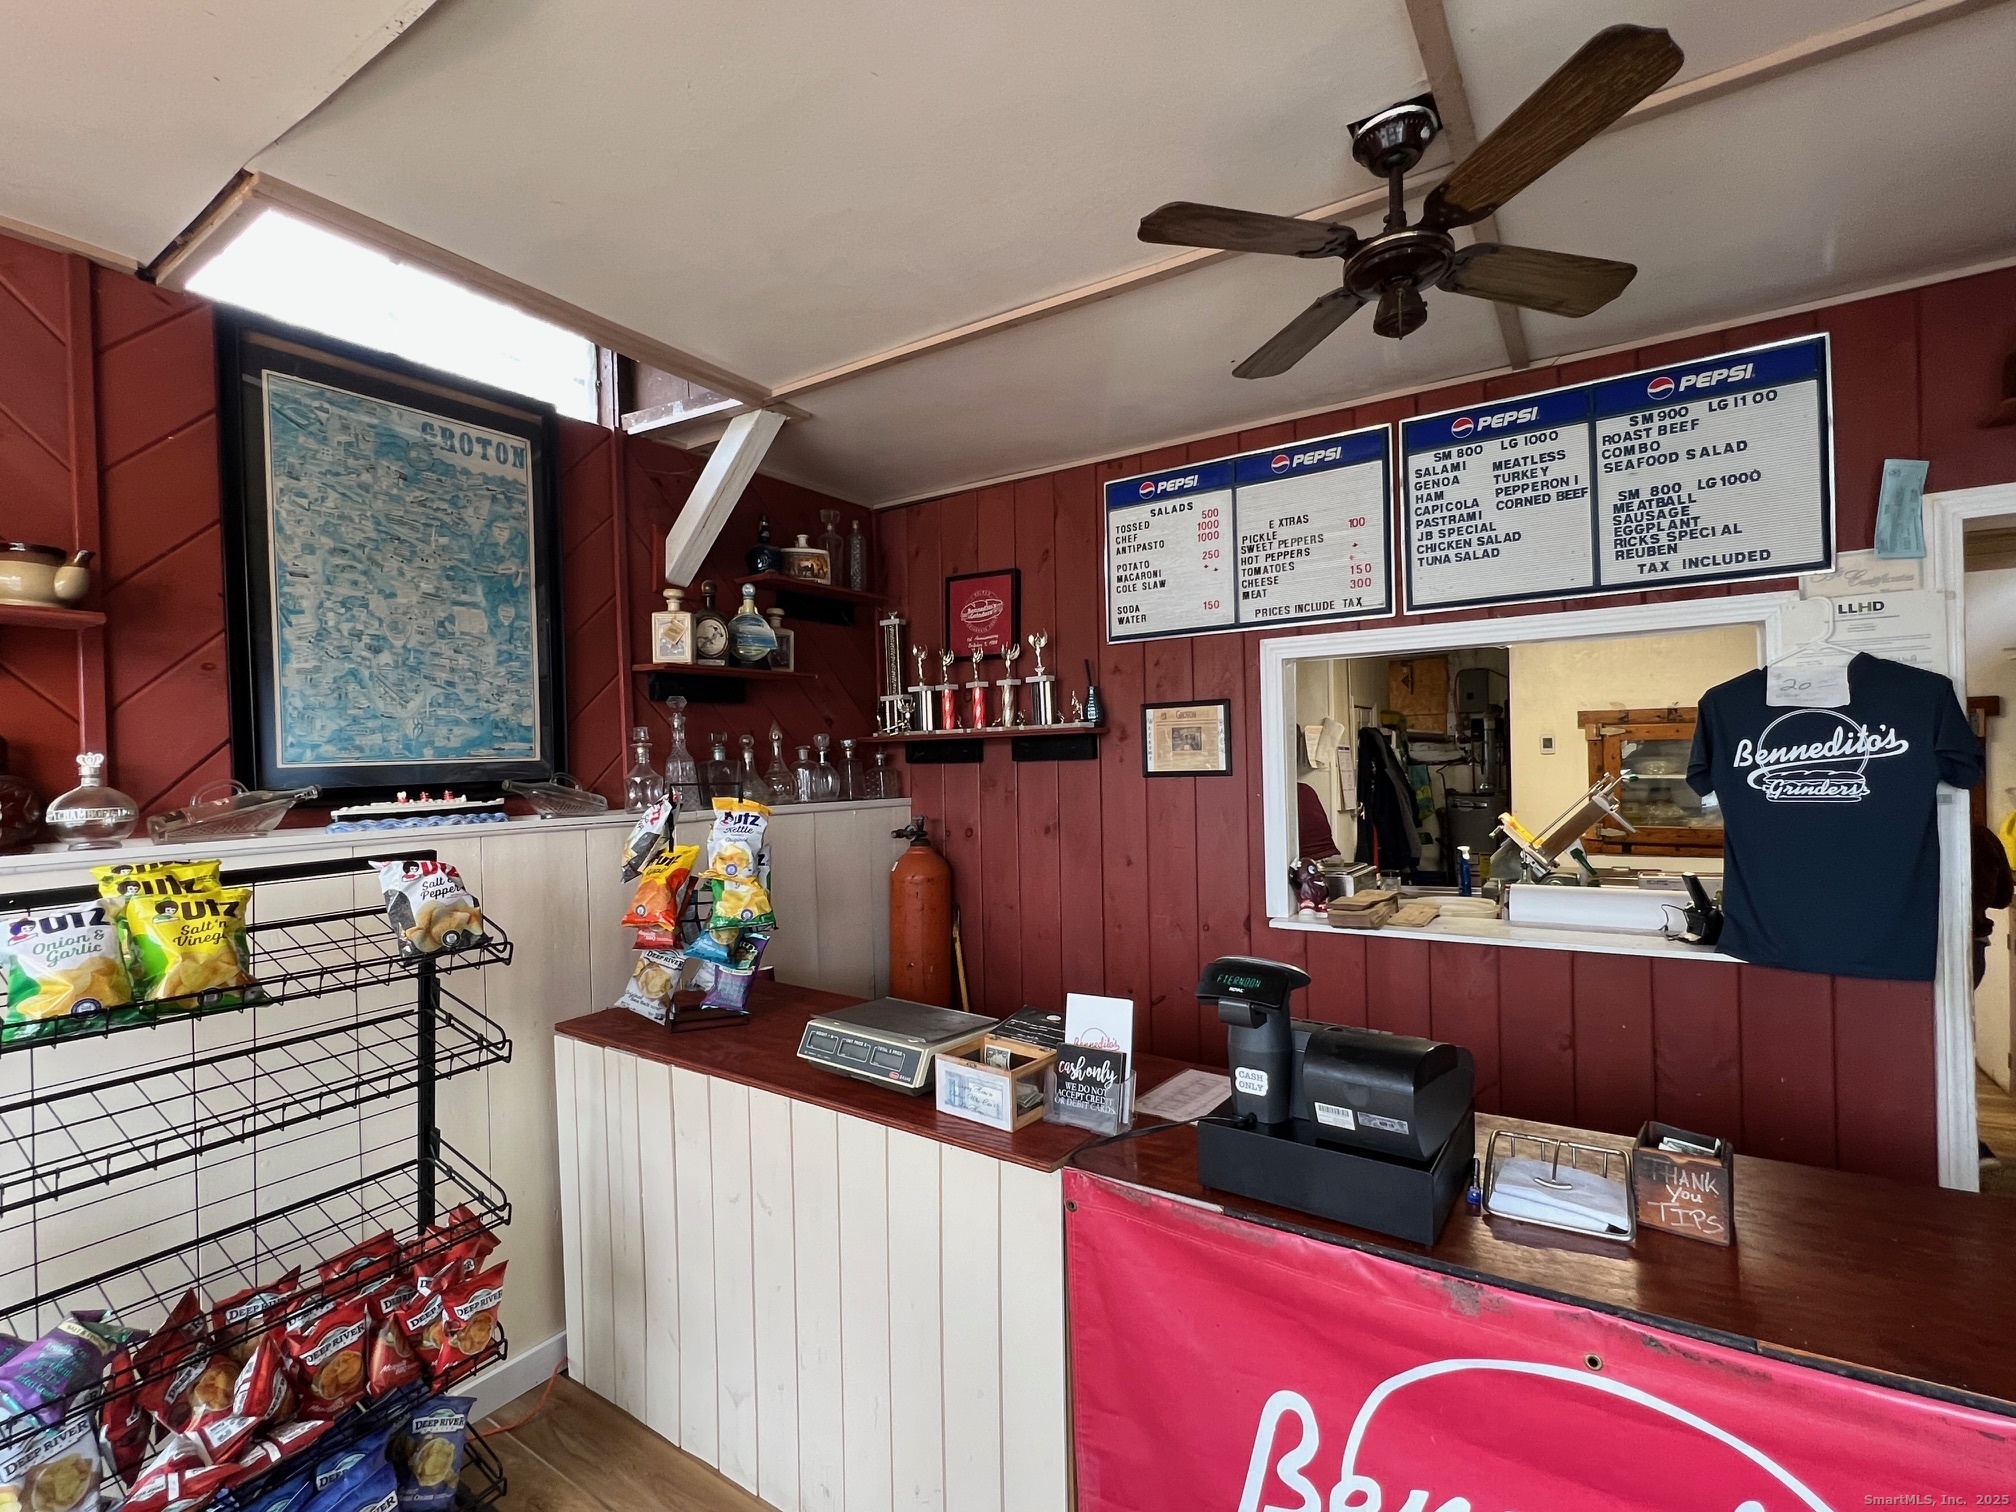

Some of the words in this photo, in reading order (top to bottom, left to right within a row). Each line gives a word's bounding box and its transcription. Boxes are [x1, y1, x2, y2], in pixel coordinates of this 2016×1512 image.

[1678, 363, 1754, 392] PEPSI
[1477, 406, 1539, 431] PEPSI
[1629, 413, 1654, 427] SM
[1657, 406, 1689, 422] 900
[1708, 399, 1729, 413] LG
[1602, 427, 1652, 447] ROAST
[1657, 418, 1700, 437] BEEF
[1292, 446, 1342, 467] PEPSI
[1434, 450, 1451, 462] SM
[1457, 445, 1483, 458] 800
[1501, 438, 1518, 450] LG
[1524, 430, 1559, 446] 1000
[1602, 440, 1661, 460] COMBO
[1604, 451, 1679, 473] SEAFOOD
[1686, 440, 1748, 460] SALAD
[1415, 461, 1467, 478] SALAMI
[1492, 450, 1566, 472] MEATLESS
[1157, 475, 1198, 494] PEPSI
[1414, 475, 1460, 491] GENOA
[1493, 466, 1549, 485] TURKEY
[1618, 489, 1640, 502] SM
[1650, 482, 1682, 497] 800
[1698, 477, 1717, 491] LG
[1720, 470, 1762, 487] 1000
[1414, 498, 1479, 516] CAPICOLA
[1416, 491, 1444, 504] HAM
[1496, 493, 1551, 511] CORNED
[1556, 486, 1589, 501] BEEF
[1613, 493, 1697, 515] MEATBALL
[1150, 502, 1194, 517] SALADS
[1416, 511, 1482, 529] PASTRAMI
[1612, 505, 1691, 526] SAUSAGE
[1116, 521, 1150, 534] TOSSED
[1202, 508, 1219, 519] 500
[1242, 531, 1277, 545] PICKLE
[1349, 517, 1365, 528] 100
[1614, 516, 1701, 538] EGGPLANT
[1116, 534, 1138, 545] CHEF
[1197, 520, 1219, 531] 1000
[1417, 530, 1433, 542] JB
[1438, 522, 1496, 539] SPECIAL
[1614, 534, 1660, 549] RICKS
[1666, 523, 1743, 543] SPECIAL
[1116, 540, 1165, 555] ANTIPASTO
[1197, 531, 1219, 542] 1000
[1241, 541, 1273, 554] SWEET
[1278, 533, 1324, 549] PEPPERS
[1416, 538, 1472, 555] CHICKEN
[1477, 531, 1522, 547] SALAD
[1615, 543, 1678, 561] REUBEN
[1117, 560, 1150, 572] POTATO
[1202, 550, 1220, 560] 250
[1241, 555, 1259, 566] HOT
[1265, 547, 1310, 562] PEPPERS
[1418, 554, 1451, 567] TUNA
[1455, 548, 1500, 562] SALAD
[1637, 561, 1670, 575] TAX
[1682, 549, 1771, 570] INCLUDED
[1116, 569, 1162, 583] MACARONI
[1241, 576, 1279, 588] CHEESE
[1350, 563, 1371, 575] 150
[1242, 562, 1295, 577] TOMATOES
[1116, 583, 1137, 594] COLE
[1142, 580, 1166, 590] SLAW
[1242, 589, 1267, 600] MEAT
[1350, 578, 1371, 589] 300
[1117, 605, 1140, 614] SODA
[1203, 600, 1220, 610] 150
[1255, 605, 1290, 618] PRICES
[1295, 601, 1335, 614] INCLUDE
[1343, 597, 1362, 608] TAX
[1838, 601, 1885, 614] LLHD
[1118, 614, 1147, 625] WATER
[1733, 724, 1908, 768] Bennedito's
[1767, 778, 1868, 798] Grinders
[420, 886, 461, 900] Pepper
[422, 877, 445, 891] Salt
[180, 919, 211, 936] Salt
[32, 934, 90, 955] Onion
[93, 929, 105, 941] &
[46, 942, 103, 968] Garlic
[1058, 1056, 1086, 1081] cash
[1086, 1060, 1118, 1089] only
[1238, 1070, 1264, 1082] CASH
[1065, 1081, 1077, 1090] WE
[1078, 1083, 1090, 1093] DO
[1091, 1086, 1107, 1097] NOT
[1238, 1080, 1264, 1092] ONLY
[1054, 1096, 1065, 1105] OR
[1067, 1097, 1089, 1110] DEBIT
[1090, 1102, 1116, 1115] CARDS
[1058, 1088, 1085, 1100] ACCEPT
[1086, 1094, 1115, 1106] CREDIT
[1643, 1157, 1718, 1198] THANK
[1648, 1202, 1724, 1234] TIPS
[230, 1307, 260, 1320] DEEP
[457, 1302, 479, 1316] DEEP
[305, 1344, 331, 1363] DEEP
[331, 1323, 365, 1348] RIVER
[415, 1419, 439, 1430] DEEP
[439, 1415, 465, 1427] RIVER
[5, 1446, 41, 1476] DEEP
[45, 1420, 90, 1452] RIVER
